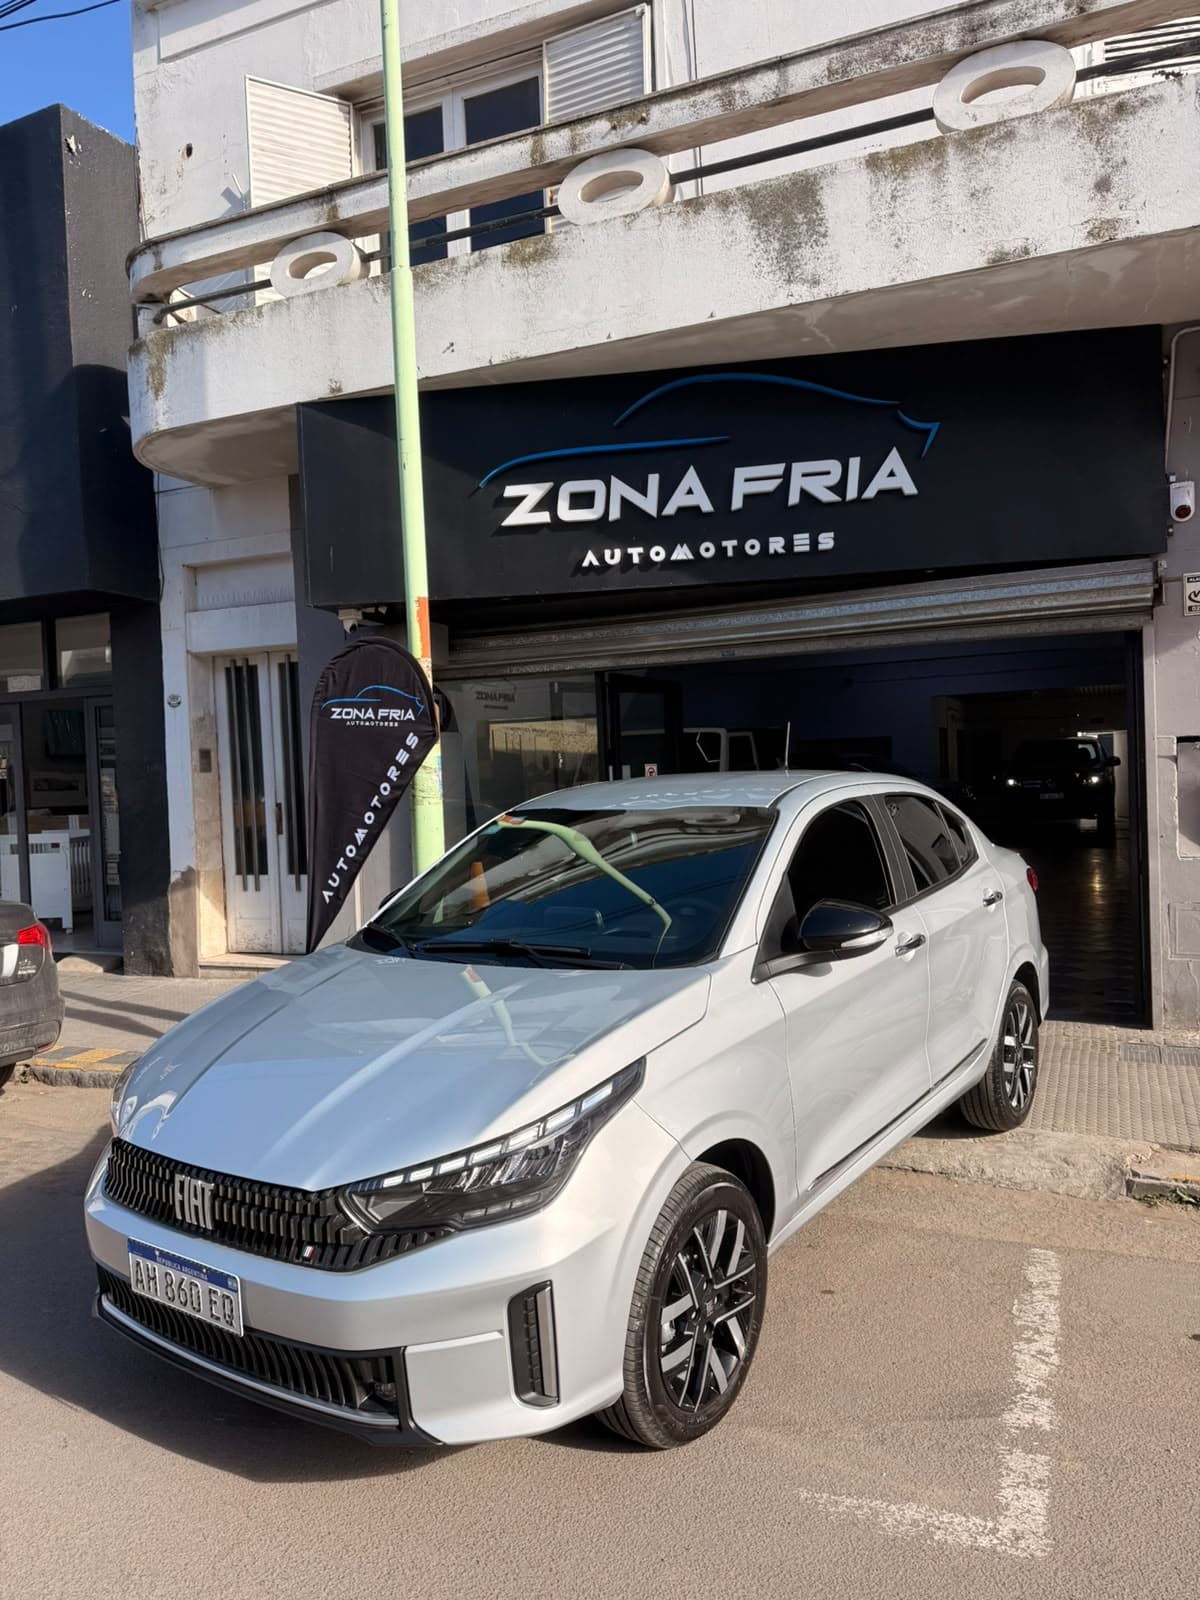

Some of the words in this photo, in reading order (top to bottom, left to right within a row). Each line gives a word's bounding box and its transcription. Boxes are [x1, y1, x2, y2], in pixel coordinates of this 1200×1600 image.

[500, 464, 715, 527] ZONA
[730, 446, 919, 512] FRIA
[582, 531, 835, 567] AUTOMOTORES
[330, 707, 375, 720] ZONA
[377, 708, 415, 721] FRIA
[321, 732, 419, 904] AUTOMOTORES
[174, 1173, 215, 1230] FIAT
[135, 1259, 160, 1297] AH
[165, 1270, 204, 1313] 860
